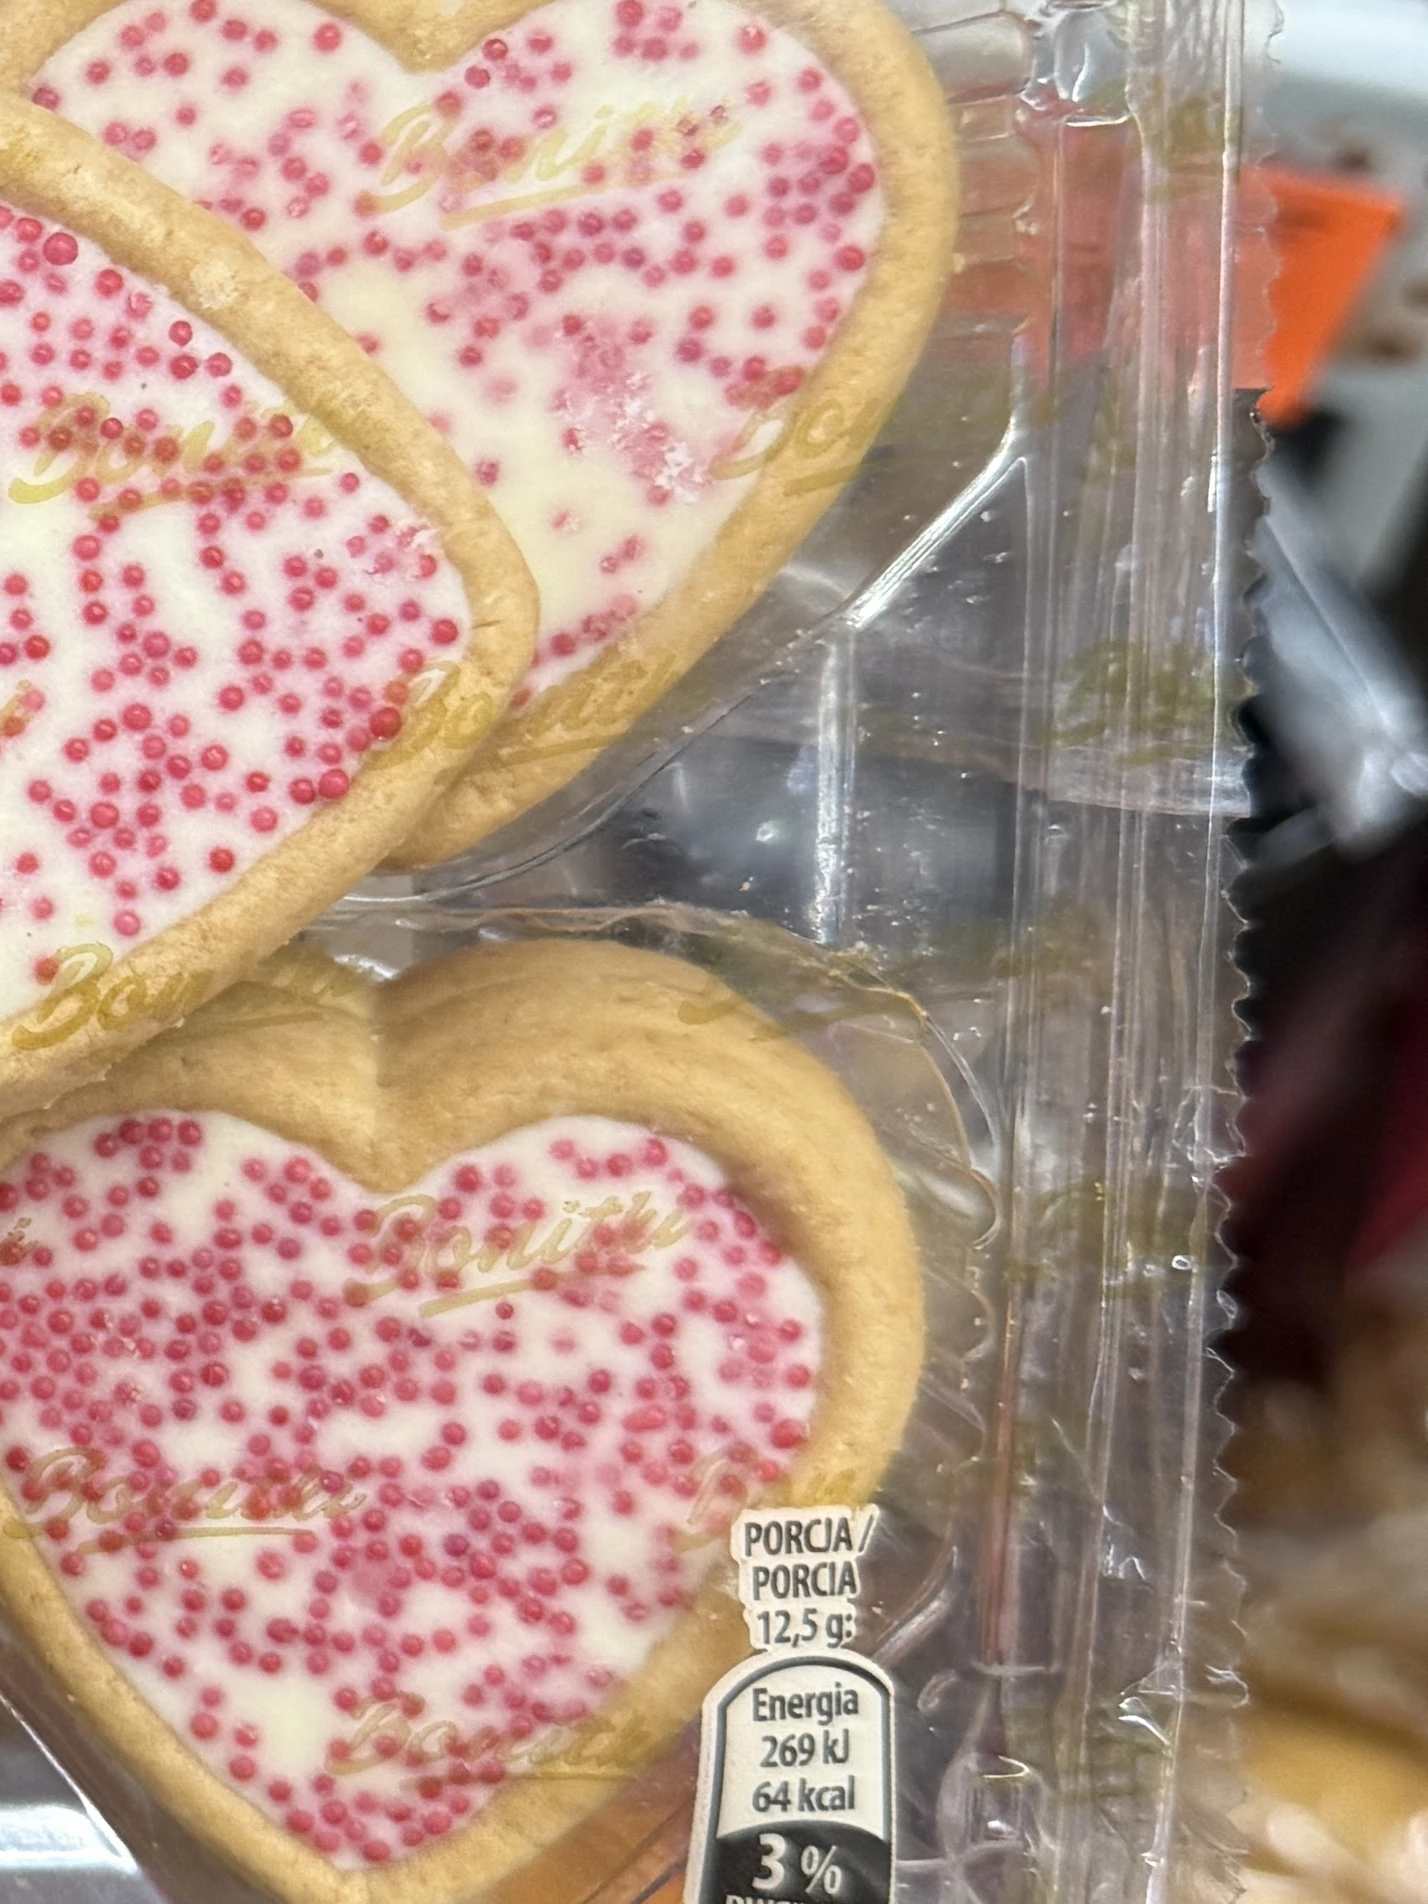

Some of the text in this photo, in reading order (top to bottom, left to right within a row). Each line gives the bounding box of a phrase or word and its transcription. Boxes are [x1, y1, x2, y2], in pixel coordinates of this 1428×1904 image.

[744, 1517, 853, 1557] PORCJA
[752, 1561, 858, 1600] PORCIA
[757, 1608, 853, 1648] 12,5 g:
[752, 1681, 859, 1726] Energia
[760, 1728, 850, 1767] 269 kJ
[752, 1774, 856, 1812] 64 kcal
[752, 1832, 843, 1895] 3 %
